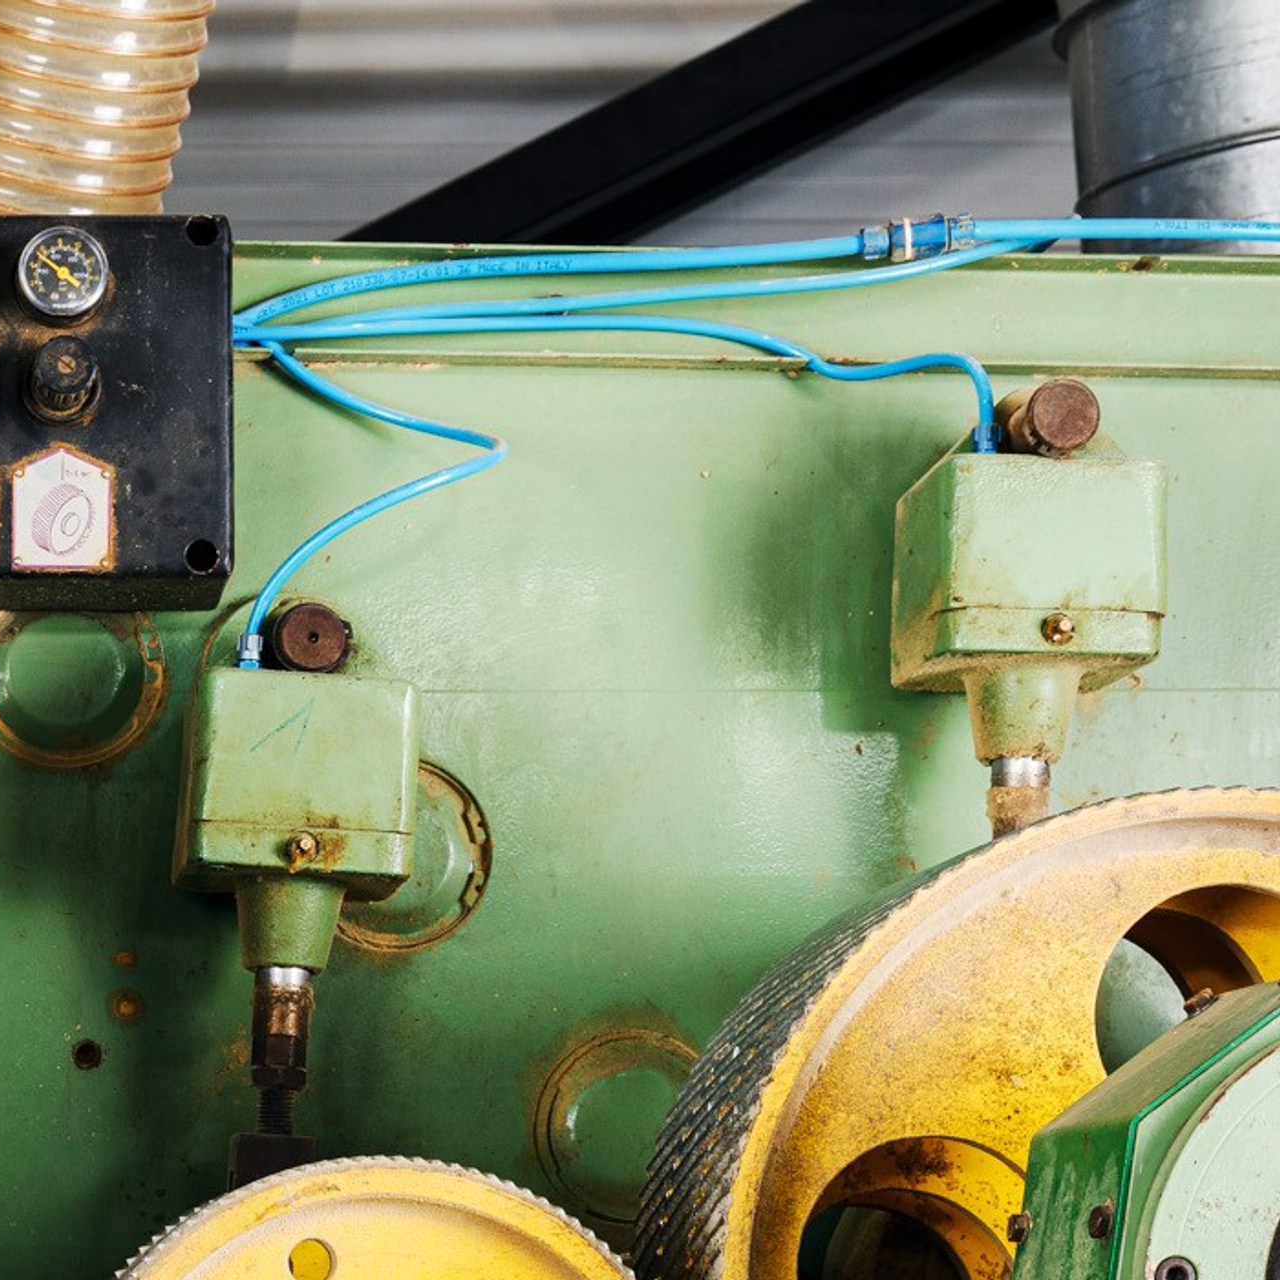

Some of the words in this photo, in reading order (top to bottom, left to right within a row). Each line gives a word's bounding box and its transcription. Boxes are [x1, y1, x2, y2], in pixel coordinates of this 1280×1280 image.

[282, 292, 308, 309] 2021
[516, 260, 530, 272] IN
[537, 259, 572, 271] ITALY
